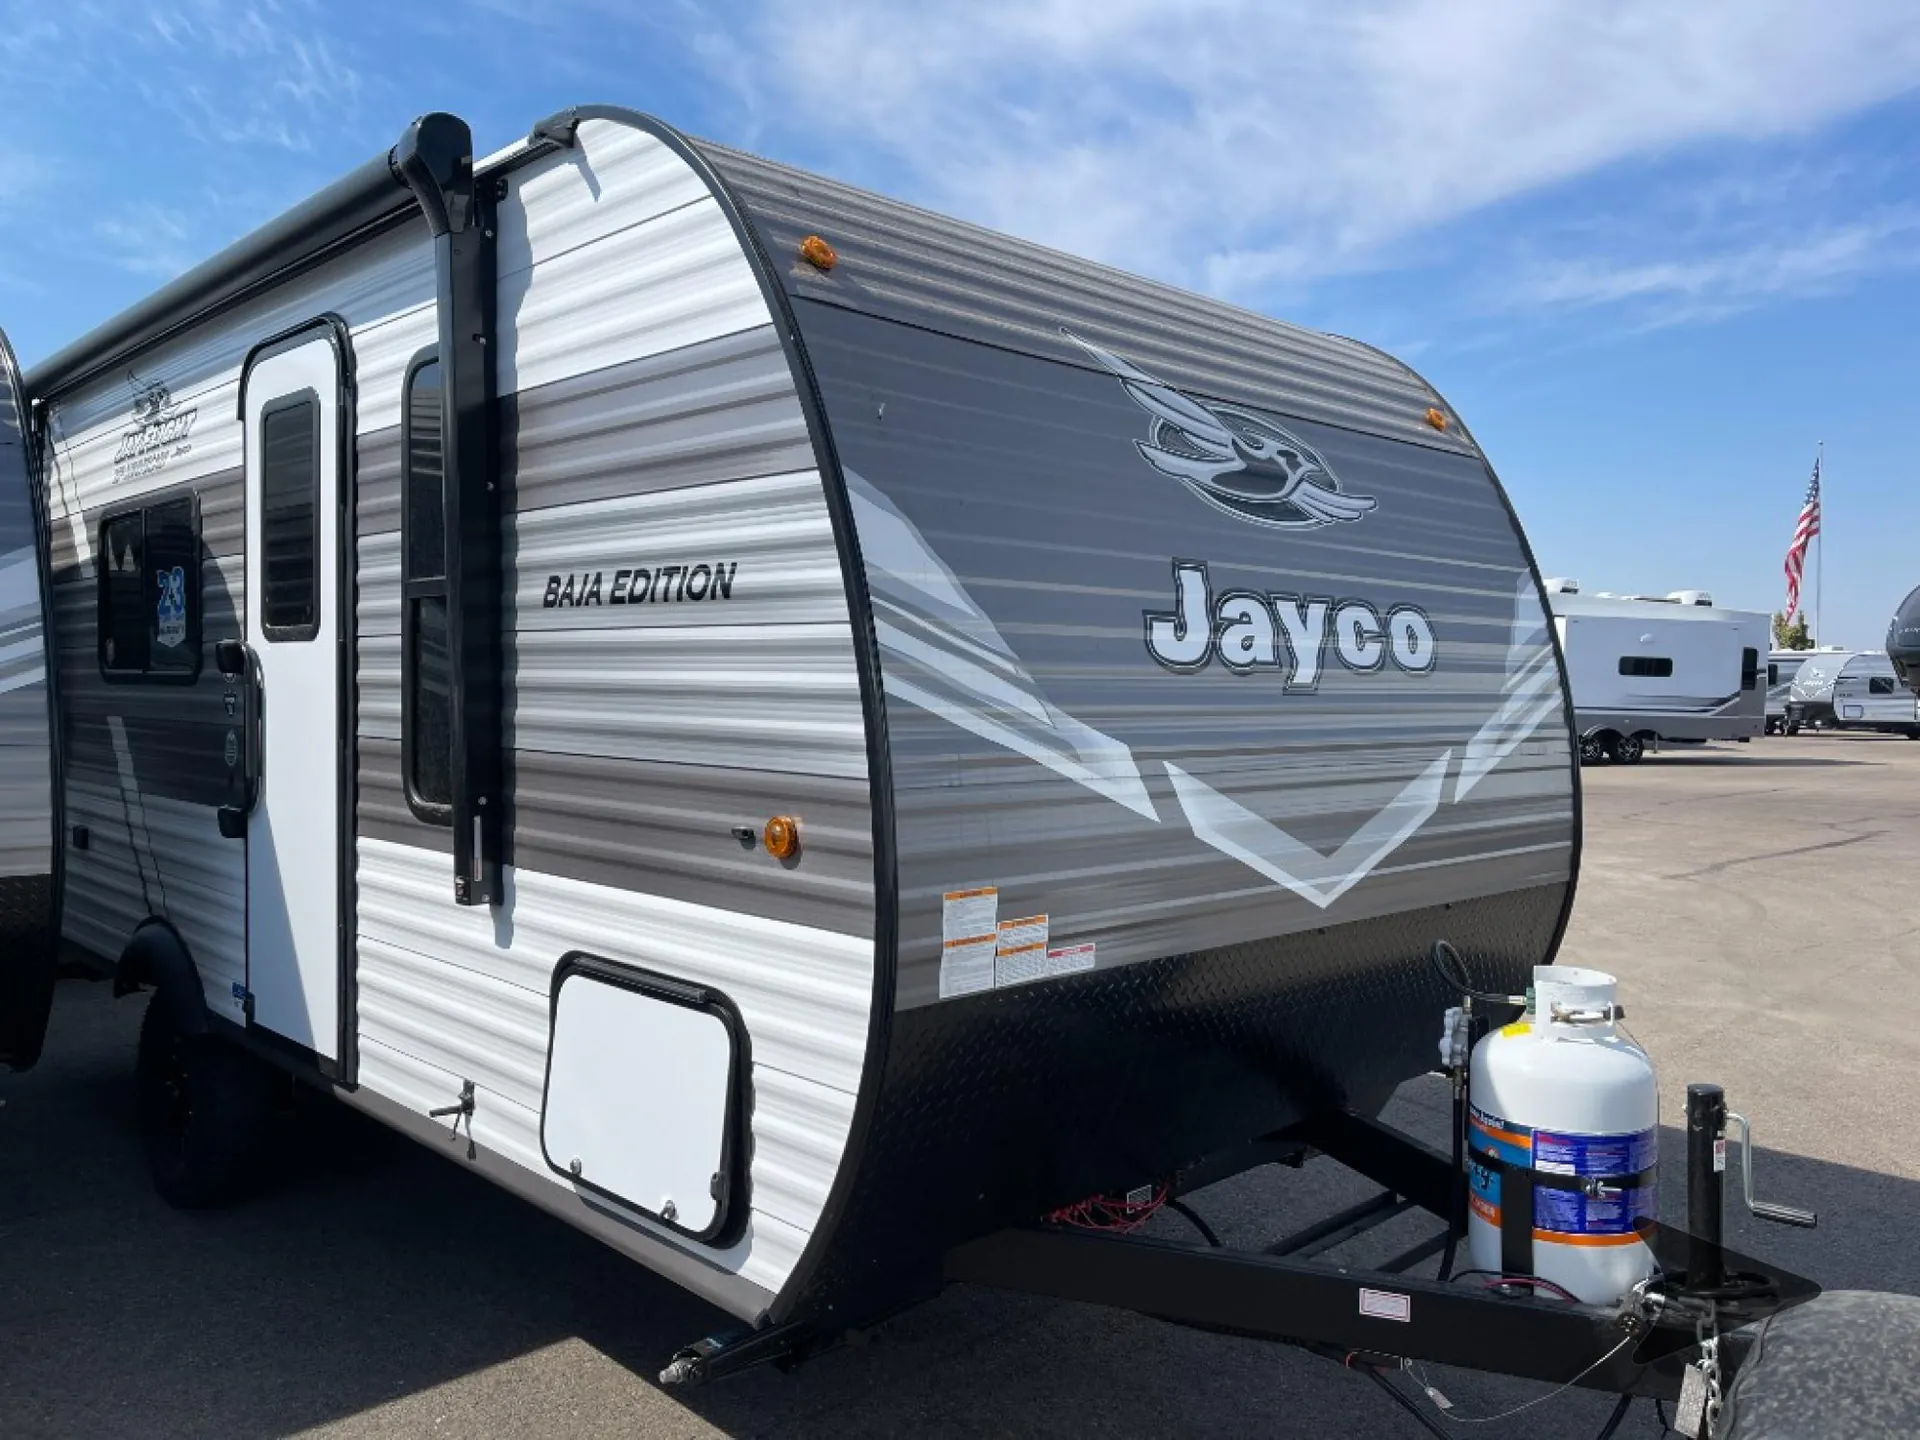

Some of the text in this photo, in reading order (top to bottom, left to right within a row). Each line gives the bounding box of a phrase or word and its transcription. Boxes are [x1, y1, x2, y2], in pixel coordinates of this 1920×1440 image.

[543, 562, 737, 608] BAJA EDITION
[1143, 557, 1437, 695] Jayco
